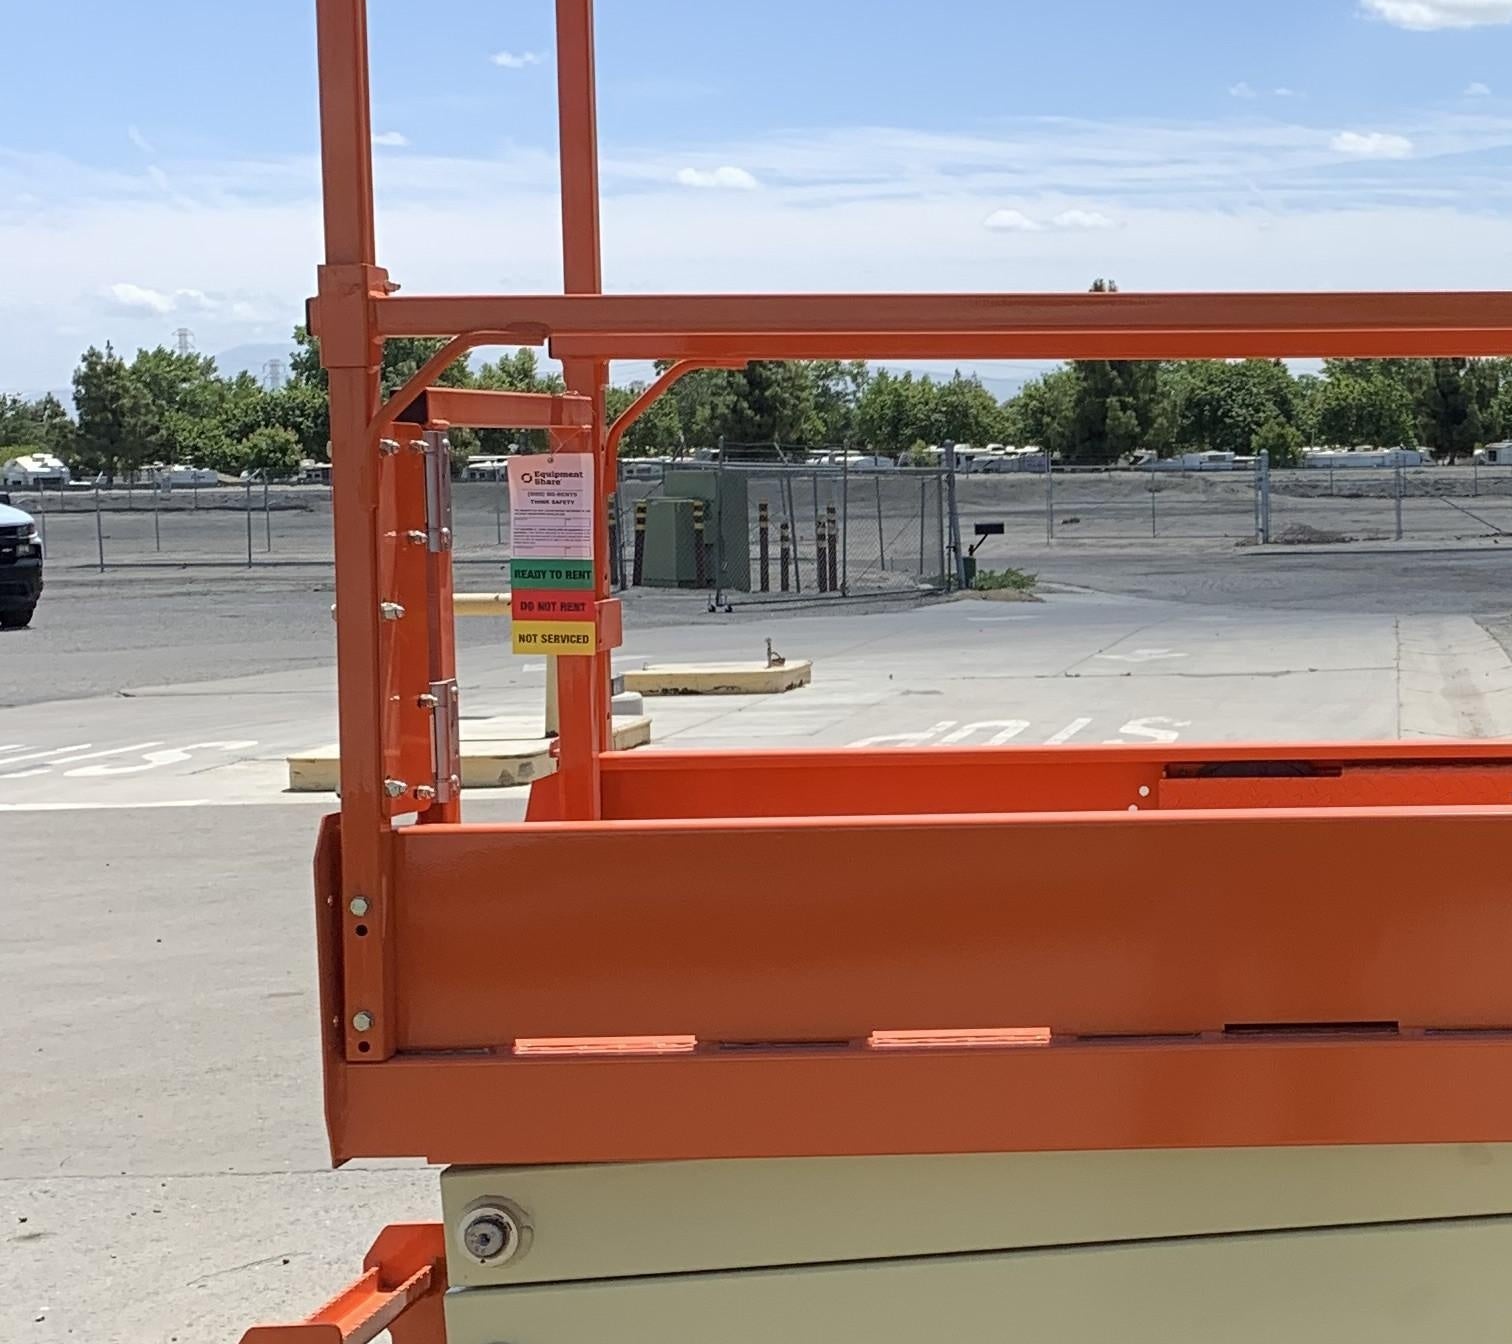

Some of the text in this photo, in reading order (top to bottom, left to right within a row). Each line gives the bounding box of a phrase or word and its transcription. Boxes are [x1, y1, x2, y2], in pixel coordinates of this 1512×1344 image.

[515, 569, 591, 580] READY TO RENT
[520, 601, 586, 612] DO NOT RENT
[518, 634, 589, 644] NOT SERVICED
